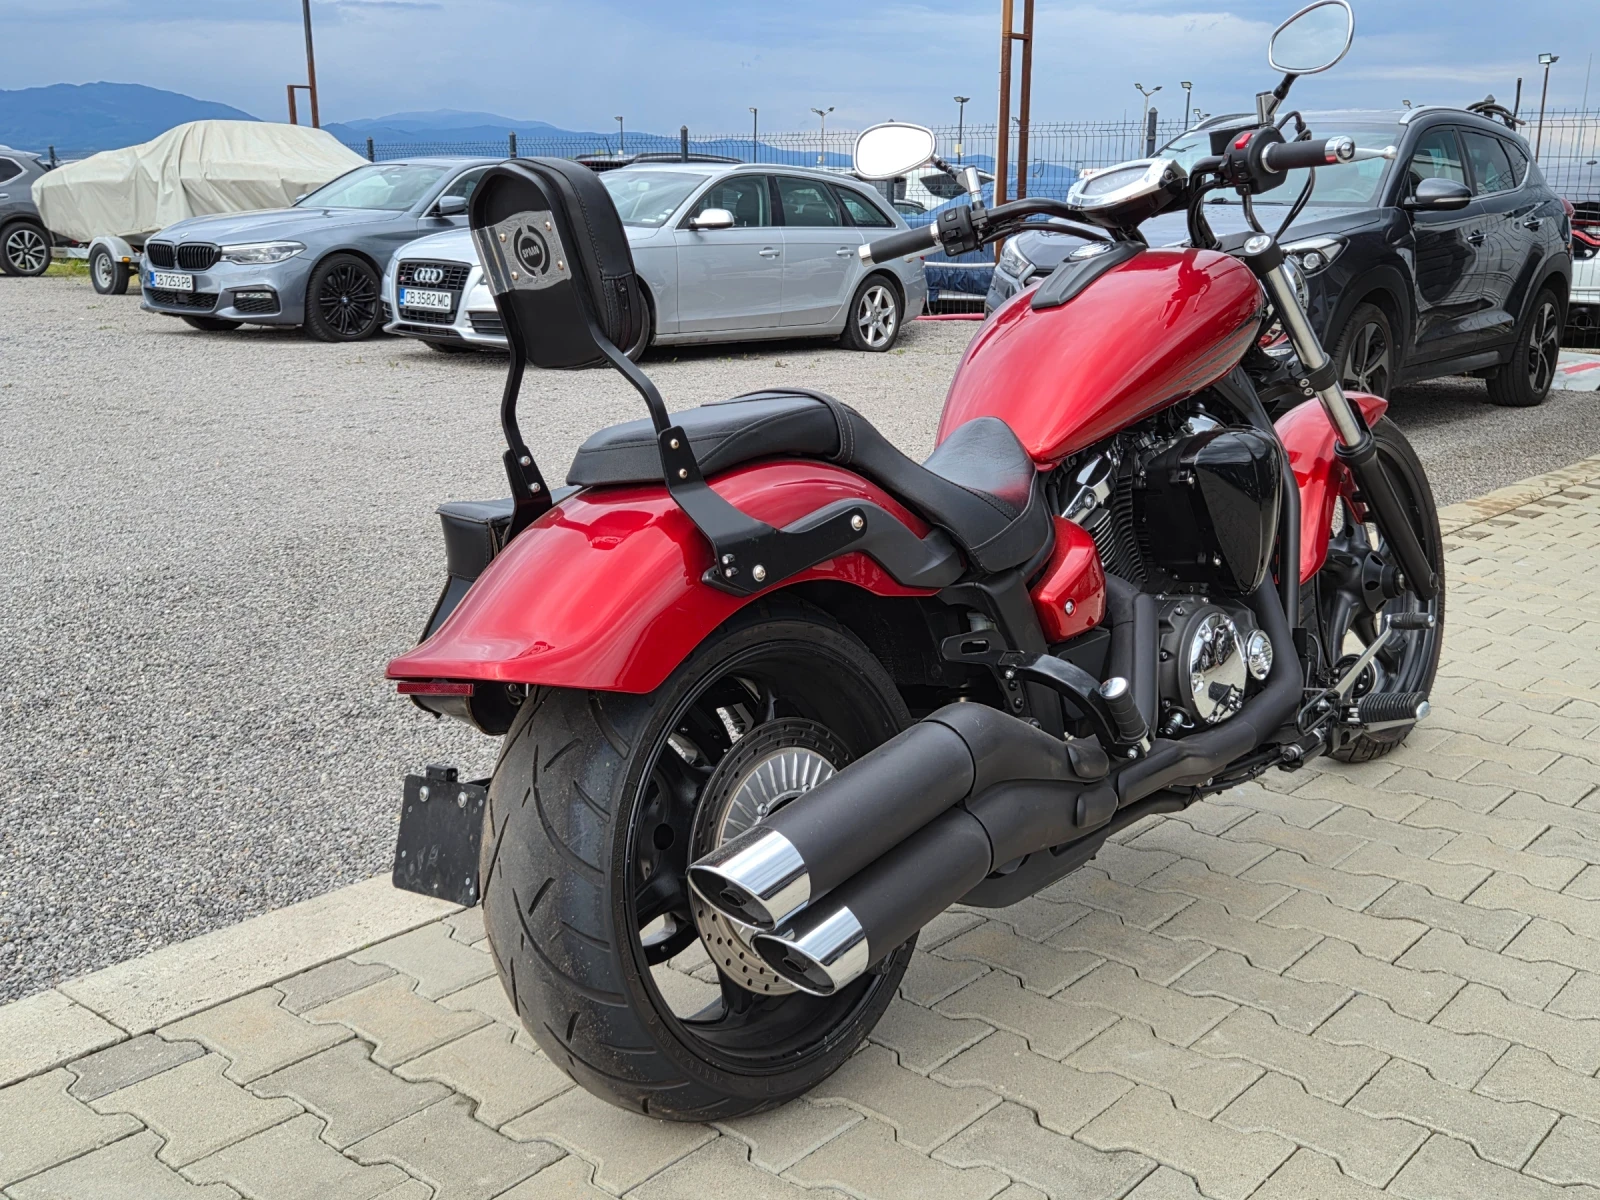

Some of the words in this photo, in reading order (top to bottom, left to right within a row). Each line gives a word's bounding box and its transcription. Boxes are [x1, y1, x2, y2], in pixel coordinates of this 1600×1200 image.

[522, 245, 540, 258] SPAAN
[164, 274, 181, 287] 7253
[181, 276, 191, 288] PB
[405, 291, 416, 304] CB
[416, 292, 437, 306] 3582
[437, 293, 449, 307] MC
